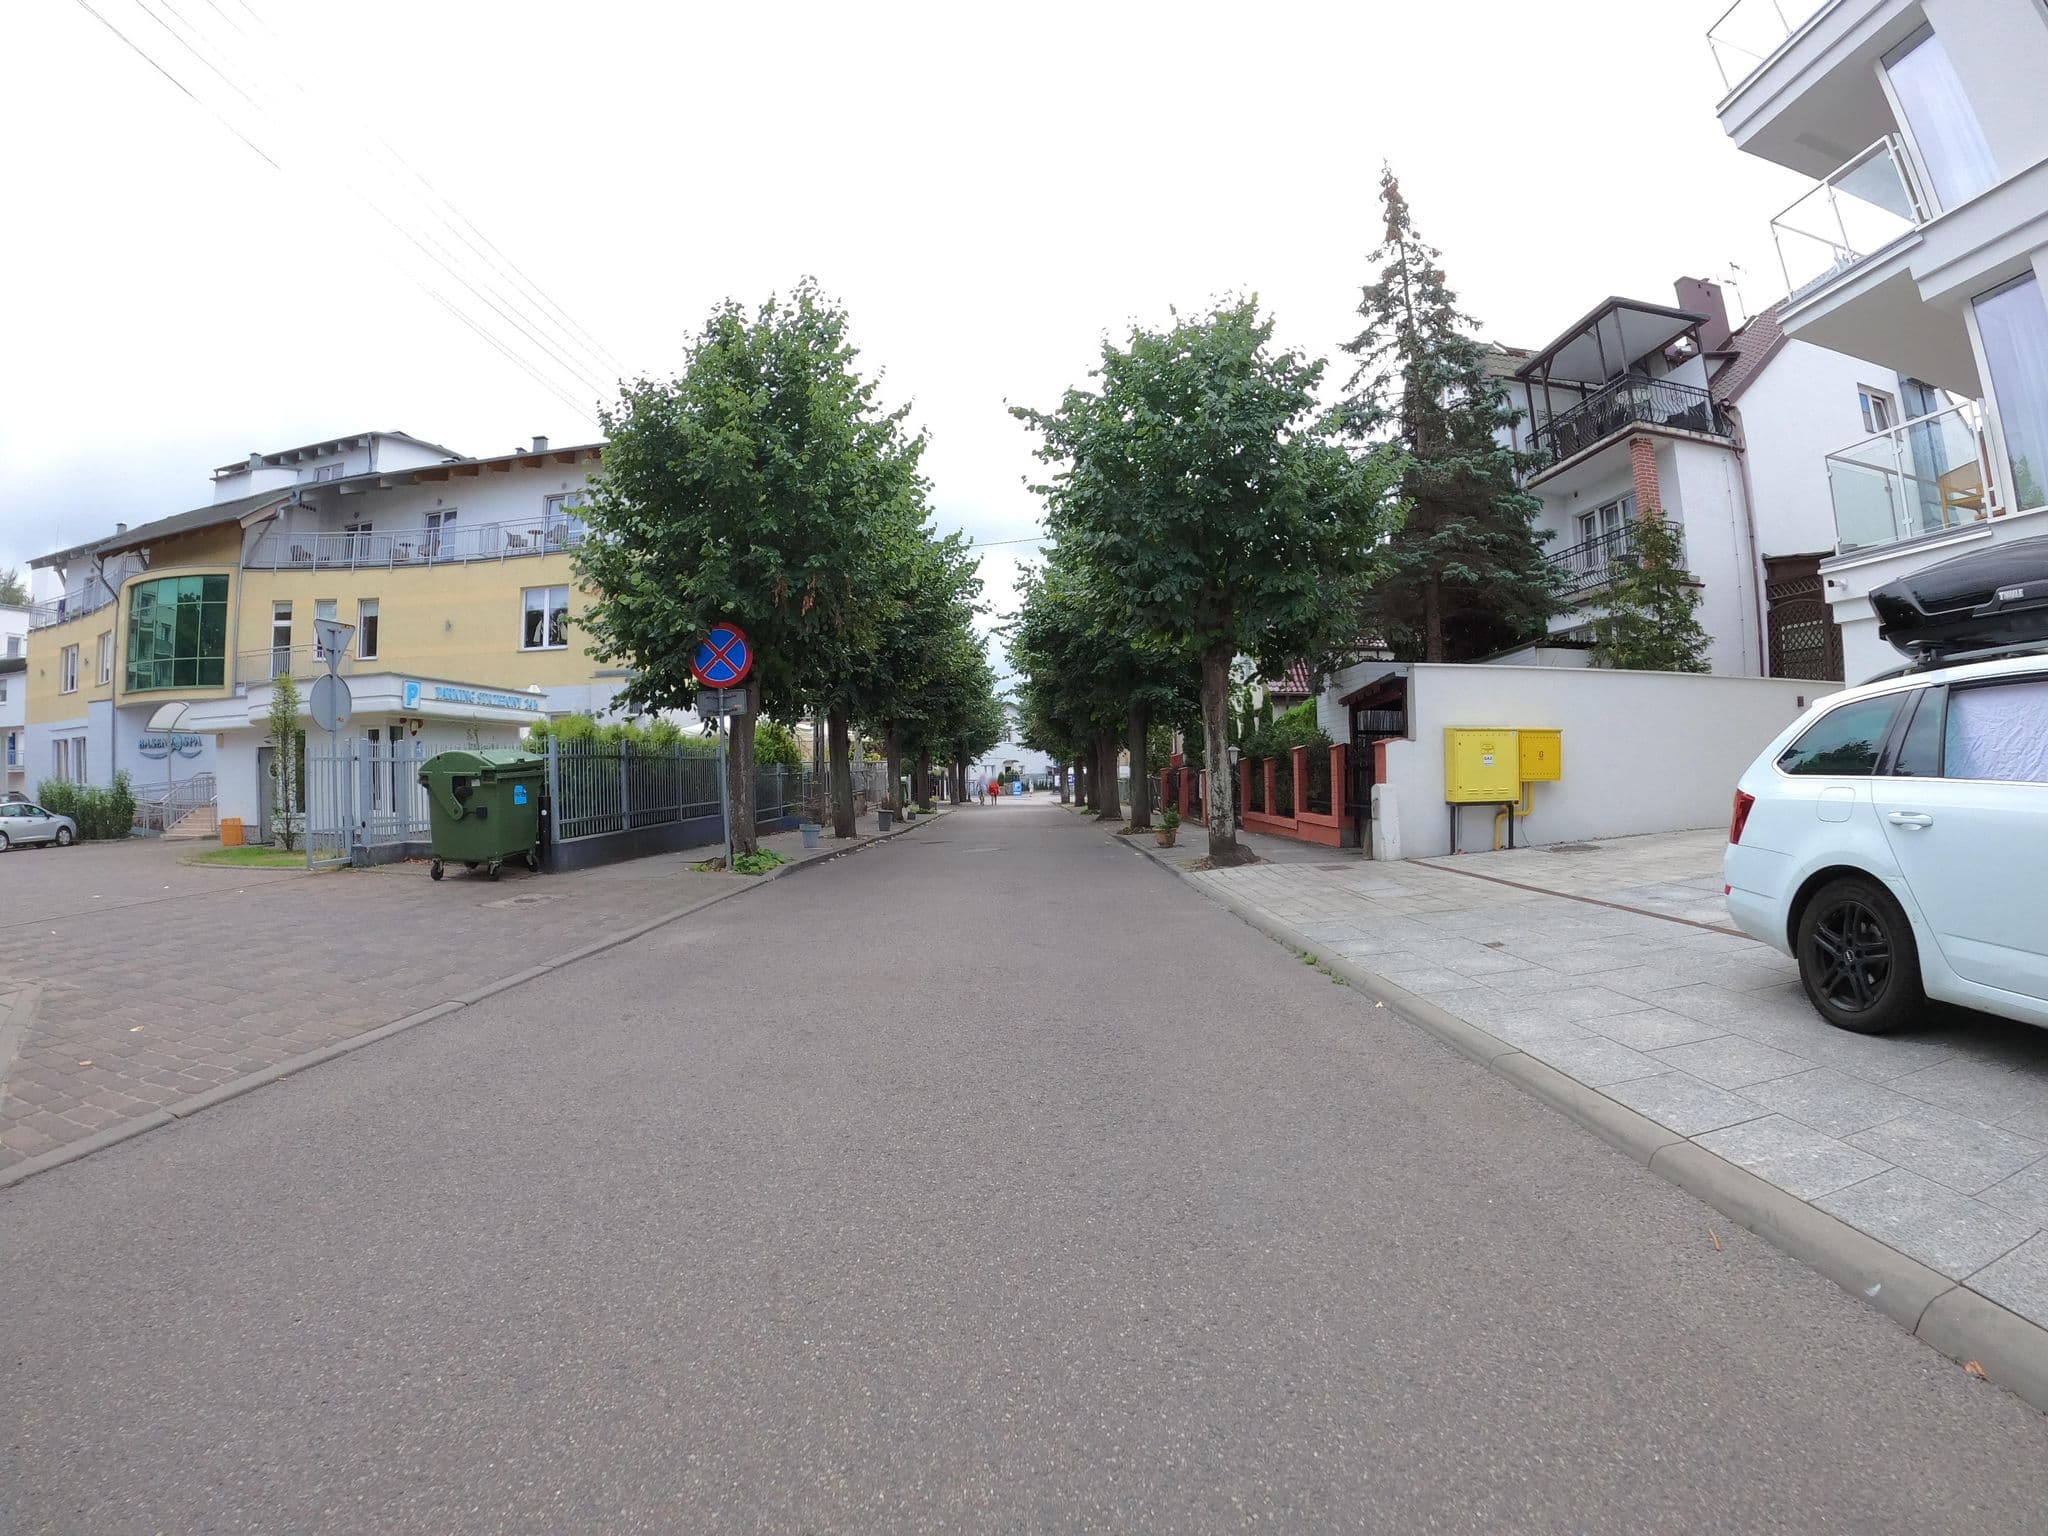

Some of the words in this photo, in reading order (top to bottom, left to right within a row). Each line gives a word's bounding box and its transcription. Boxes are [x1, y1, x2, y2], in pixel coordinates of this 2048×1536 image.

[1998, 589, 2024, 601] THULE
[406, 683, 418, 705] P
[184, 735, 202, 747] SPA
